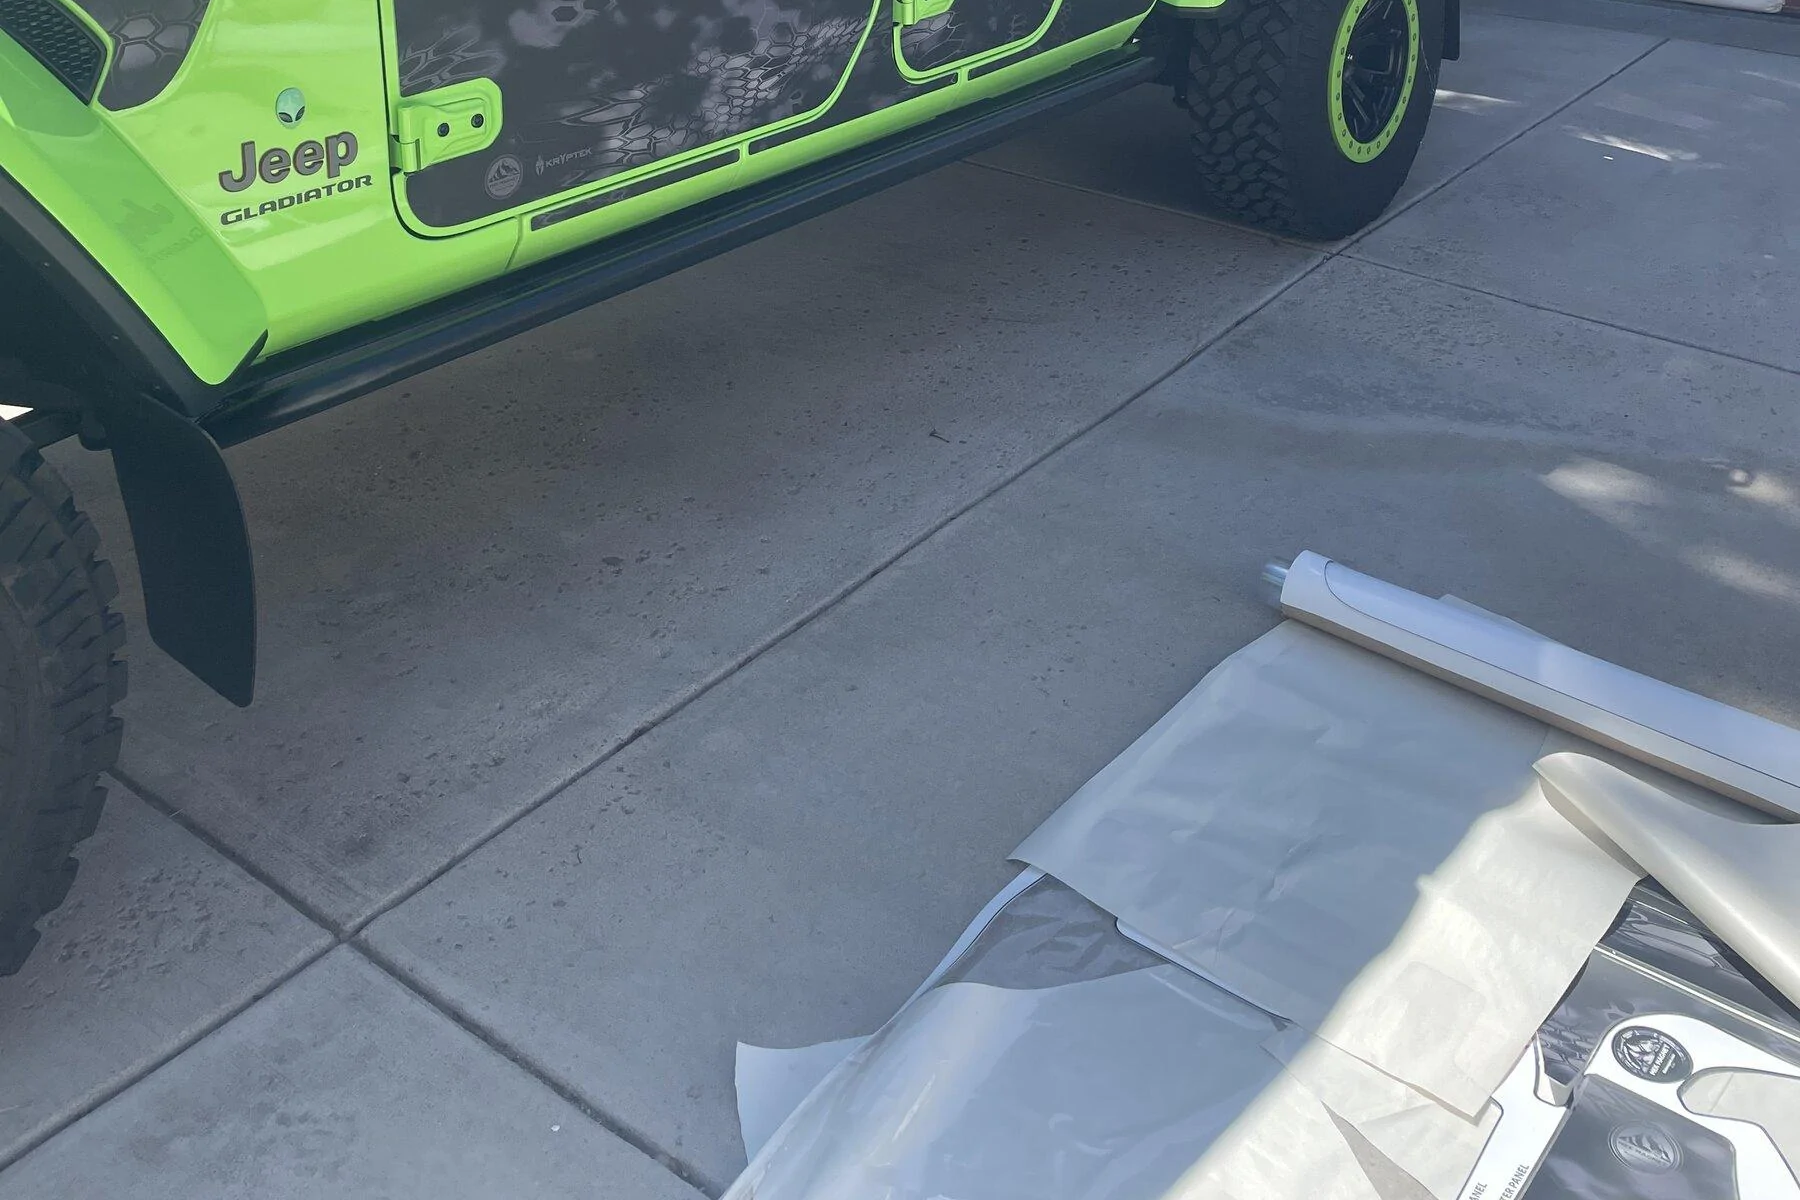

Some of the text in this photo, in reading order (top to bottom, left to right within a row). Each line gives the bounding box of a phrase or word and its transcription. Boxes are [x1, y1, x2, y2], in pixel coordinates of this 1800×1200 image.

[218, 131, 359, 193] Jeep
[545, 147, 593, 168] KRYPTEK
[220, 175, 373, 226] GLADIATOR
[1508, 1164, 1530, 1189] PANEL
